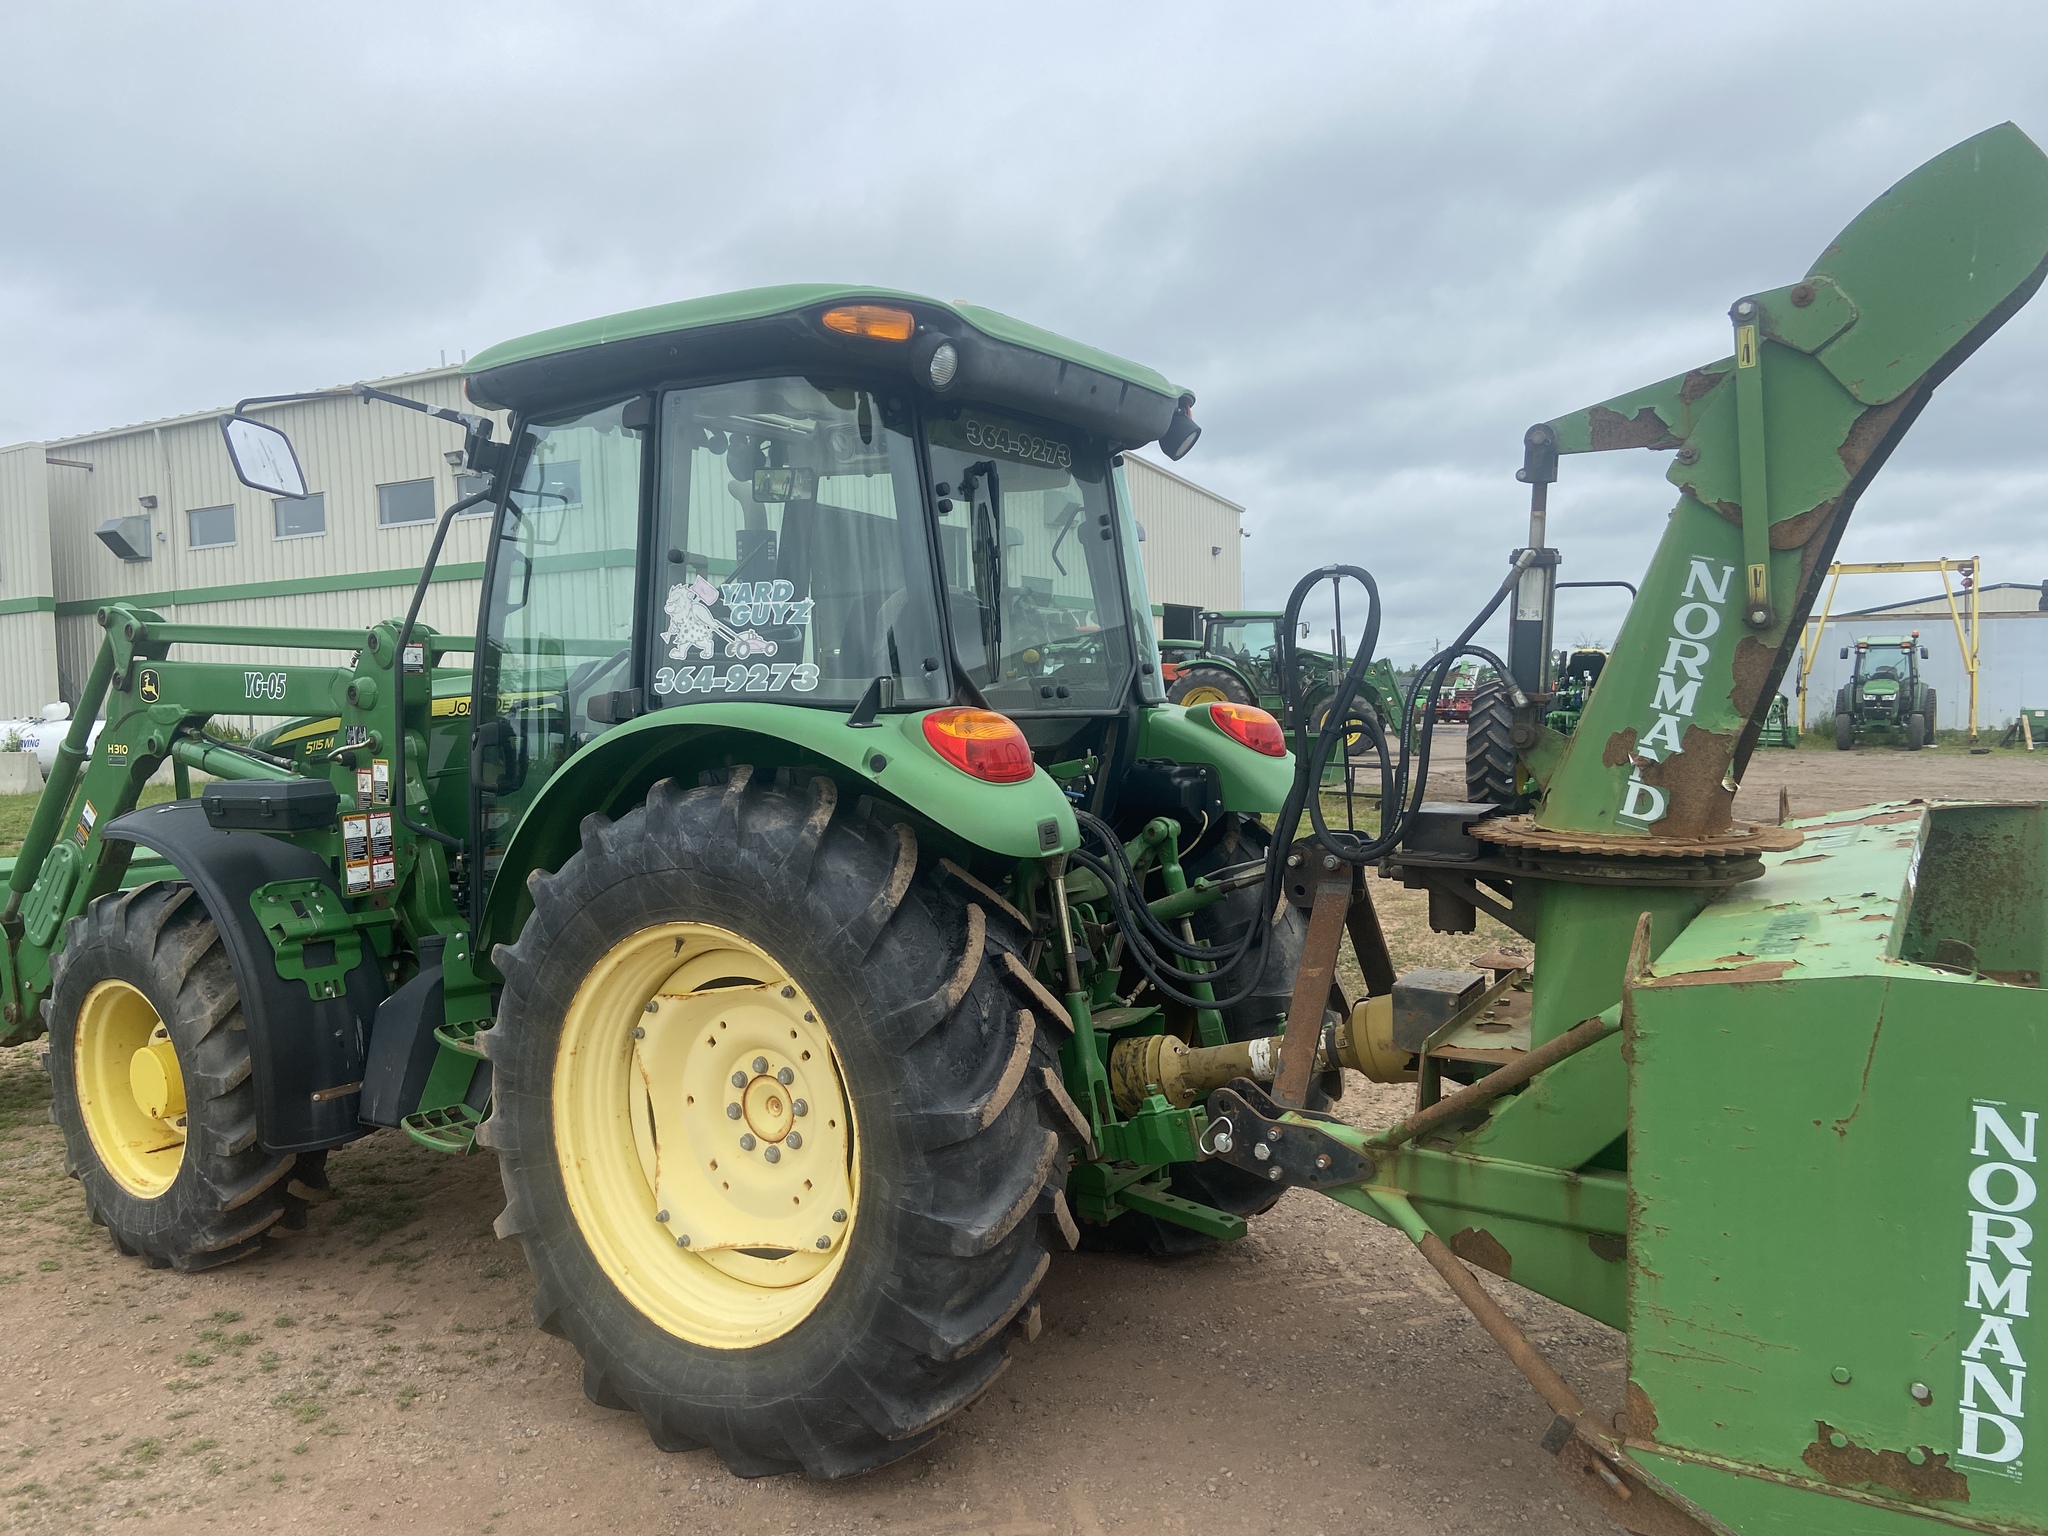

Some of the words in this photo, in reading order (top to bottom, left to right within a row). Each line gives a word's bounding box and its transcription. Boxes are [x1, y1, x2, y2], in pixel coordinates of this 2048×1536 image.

[966, 420, 1072, 467] 364-9273
[720, 579, 795, 606] YARD
[730, 600, 815, 626] GUYZ
[244, 671, 287, 700] YG-05
[653, 662, 820, 694] 364-9273
[18, 738, 40, 748] RVING
[1957, 1105, 2039, 1463] NORMAND
